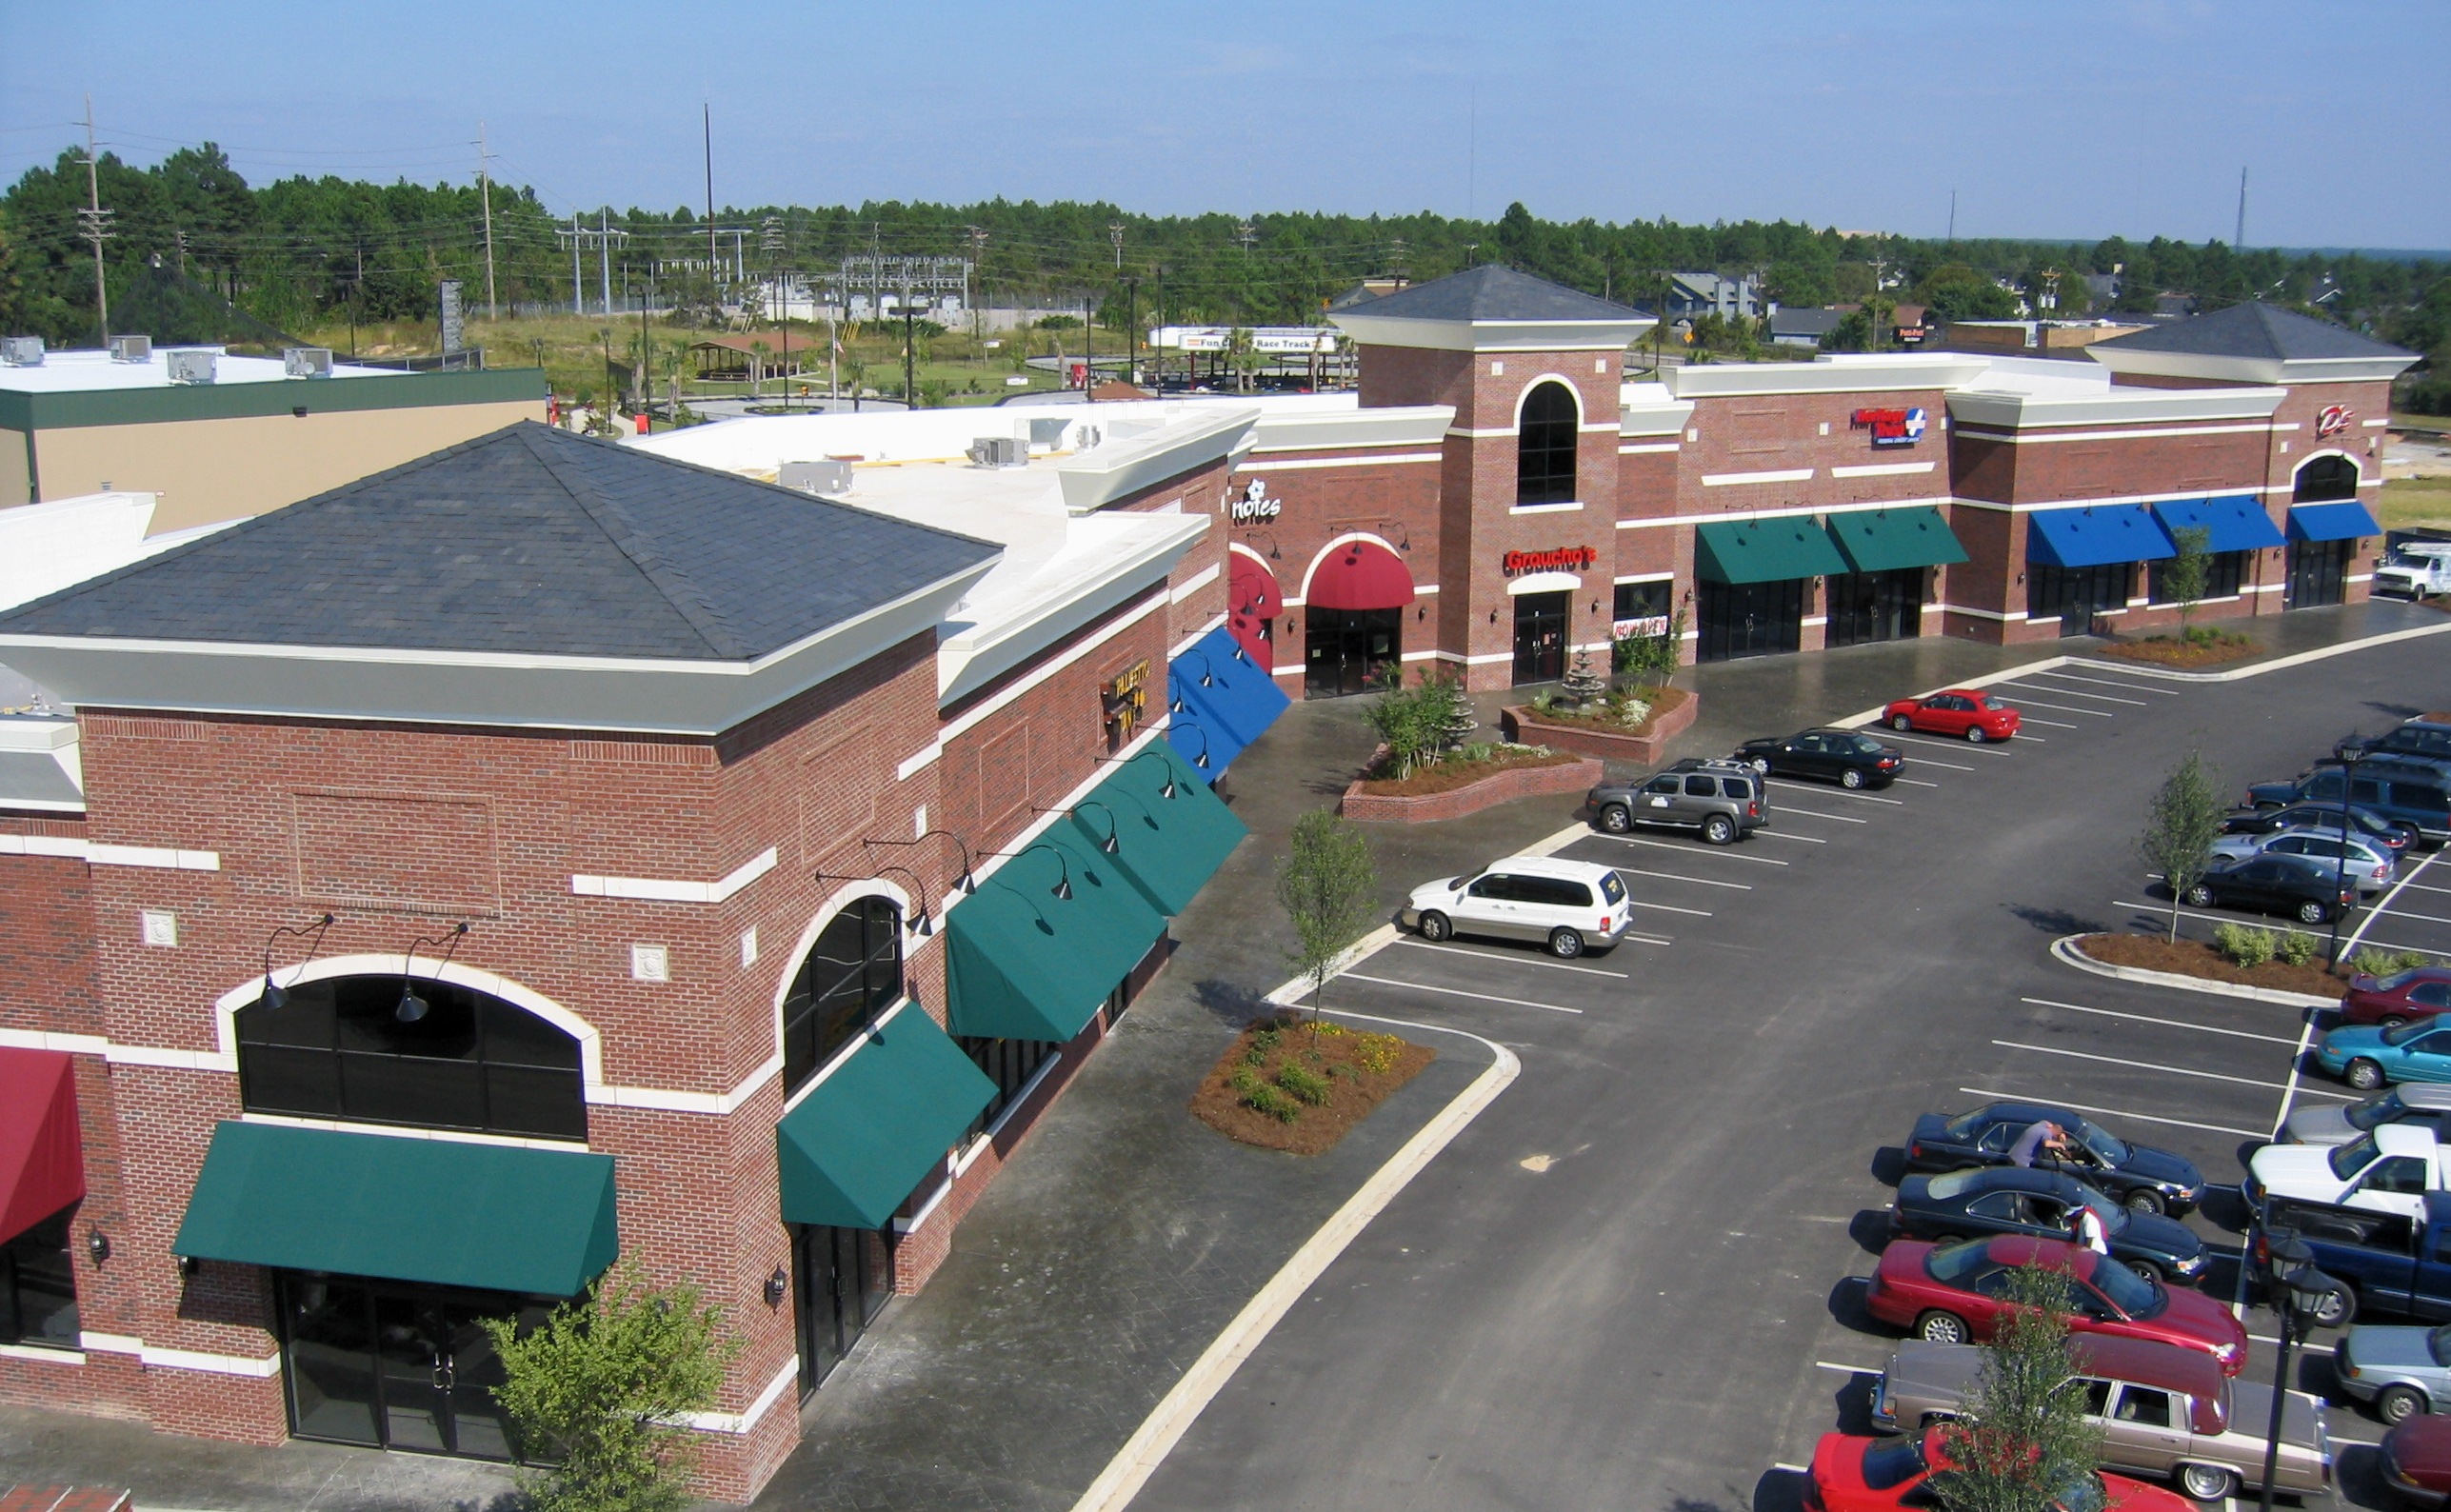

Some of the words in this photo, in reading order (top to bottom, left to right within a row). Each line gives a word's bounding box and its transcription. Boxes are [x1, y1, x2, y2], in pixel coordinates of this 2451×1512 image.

[1201, 338, 1220, 347] Fun
[1256, 339, 1280, 348] Race
[1284, 340, 1310, 348] Track
[1507, 546, 1597, 569] Groucho's
